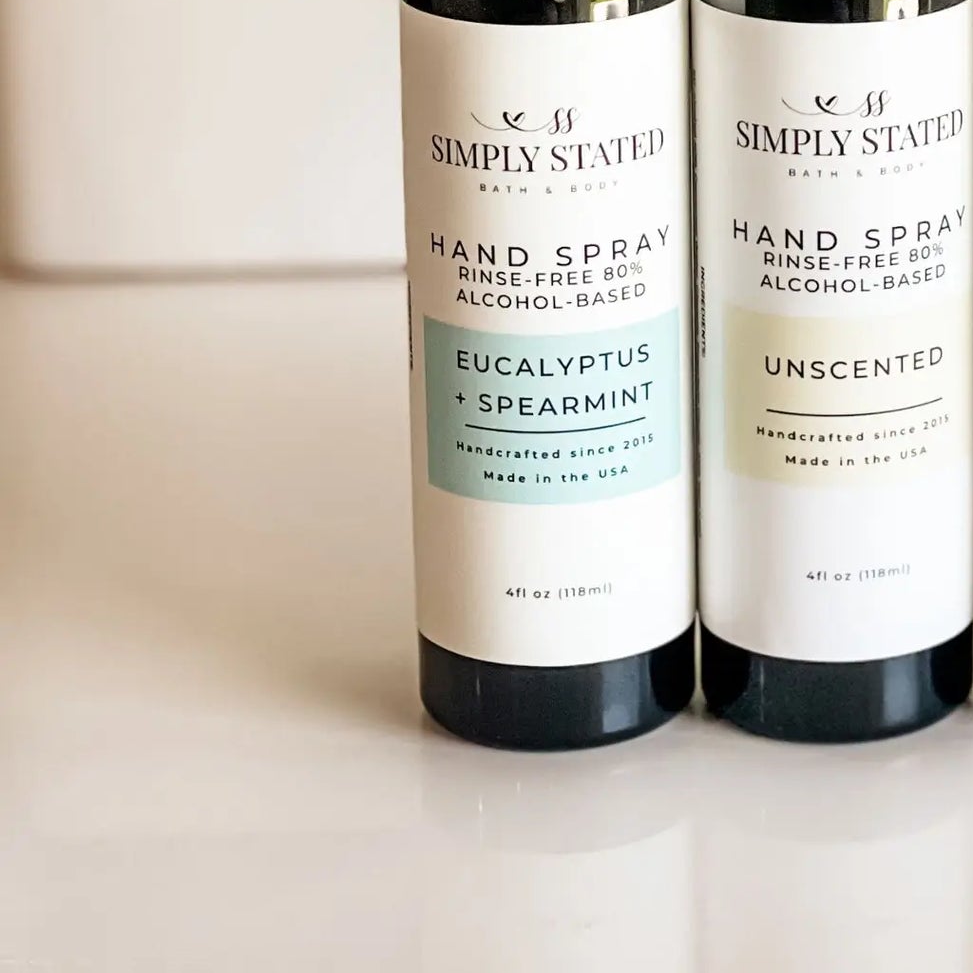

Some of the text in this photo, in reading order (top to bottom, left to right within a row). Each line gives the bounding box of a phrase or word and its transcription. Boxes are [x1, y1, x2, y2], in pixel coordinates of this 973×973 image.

[737, 108, 963, 156] SIMPLY STATED
[432, 127, 664, 173] SIMPLY STATED
[480, 180, 619, 194] BATH & BODY
[789, 169, 837, 178] BATH
[856, 169, 863, 177] &
[733, 205, 966, 251] HAND SPRAY
[430, 225, 669, 267] HAND SPRAY
[764, 242, 944, 270] RINSE-FREE 80%
[459, 259, 643, 287] RINSE-FREE 80%
[760, 264, 946, 293] ALCOHOL-BASED
[456, 283, 646, 309] ALCOHOL-BASED
[457, 344, 649, 377] EUCALYPTUS
[765, 346, 944, 379] UNSCENTED
[455, 381, 653, 416] + SPEARMINT
[757, 414, 950, 442] Handcrafted since 2015
[456, 433, 654, 459] Handcrafted since 2015
[785, 446, 927, 467] Made in the USA
[484, 465, 628, 483] Made in the USA
[806, 564, 911, 583] 4fl oz (118ml)
[506, 583, 612, 600] 4fl oz (118ml)
